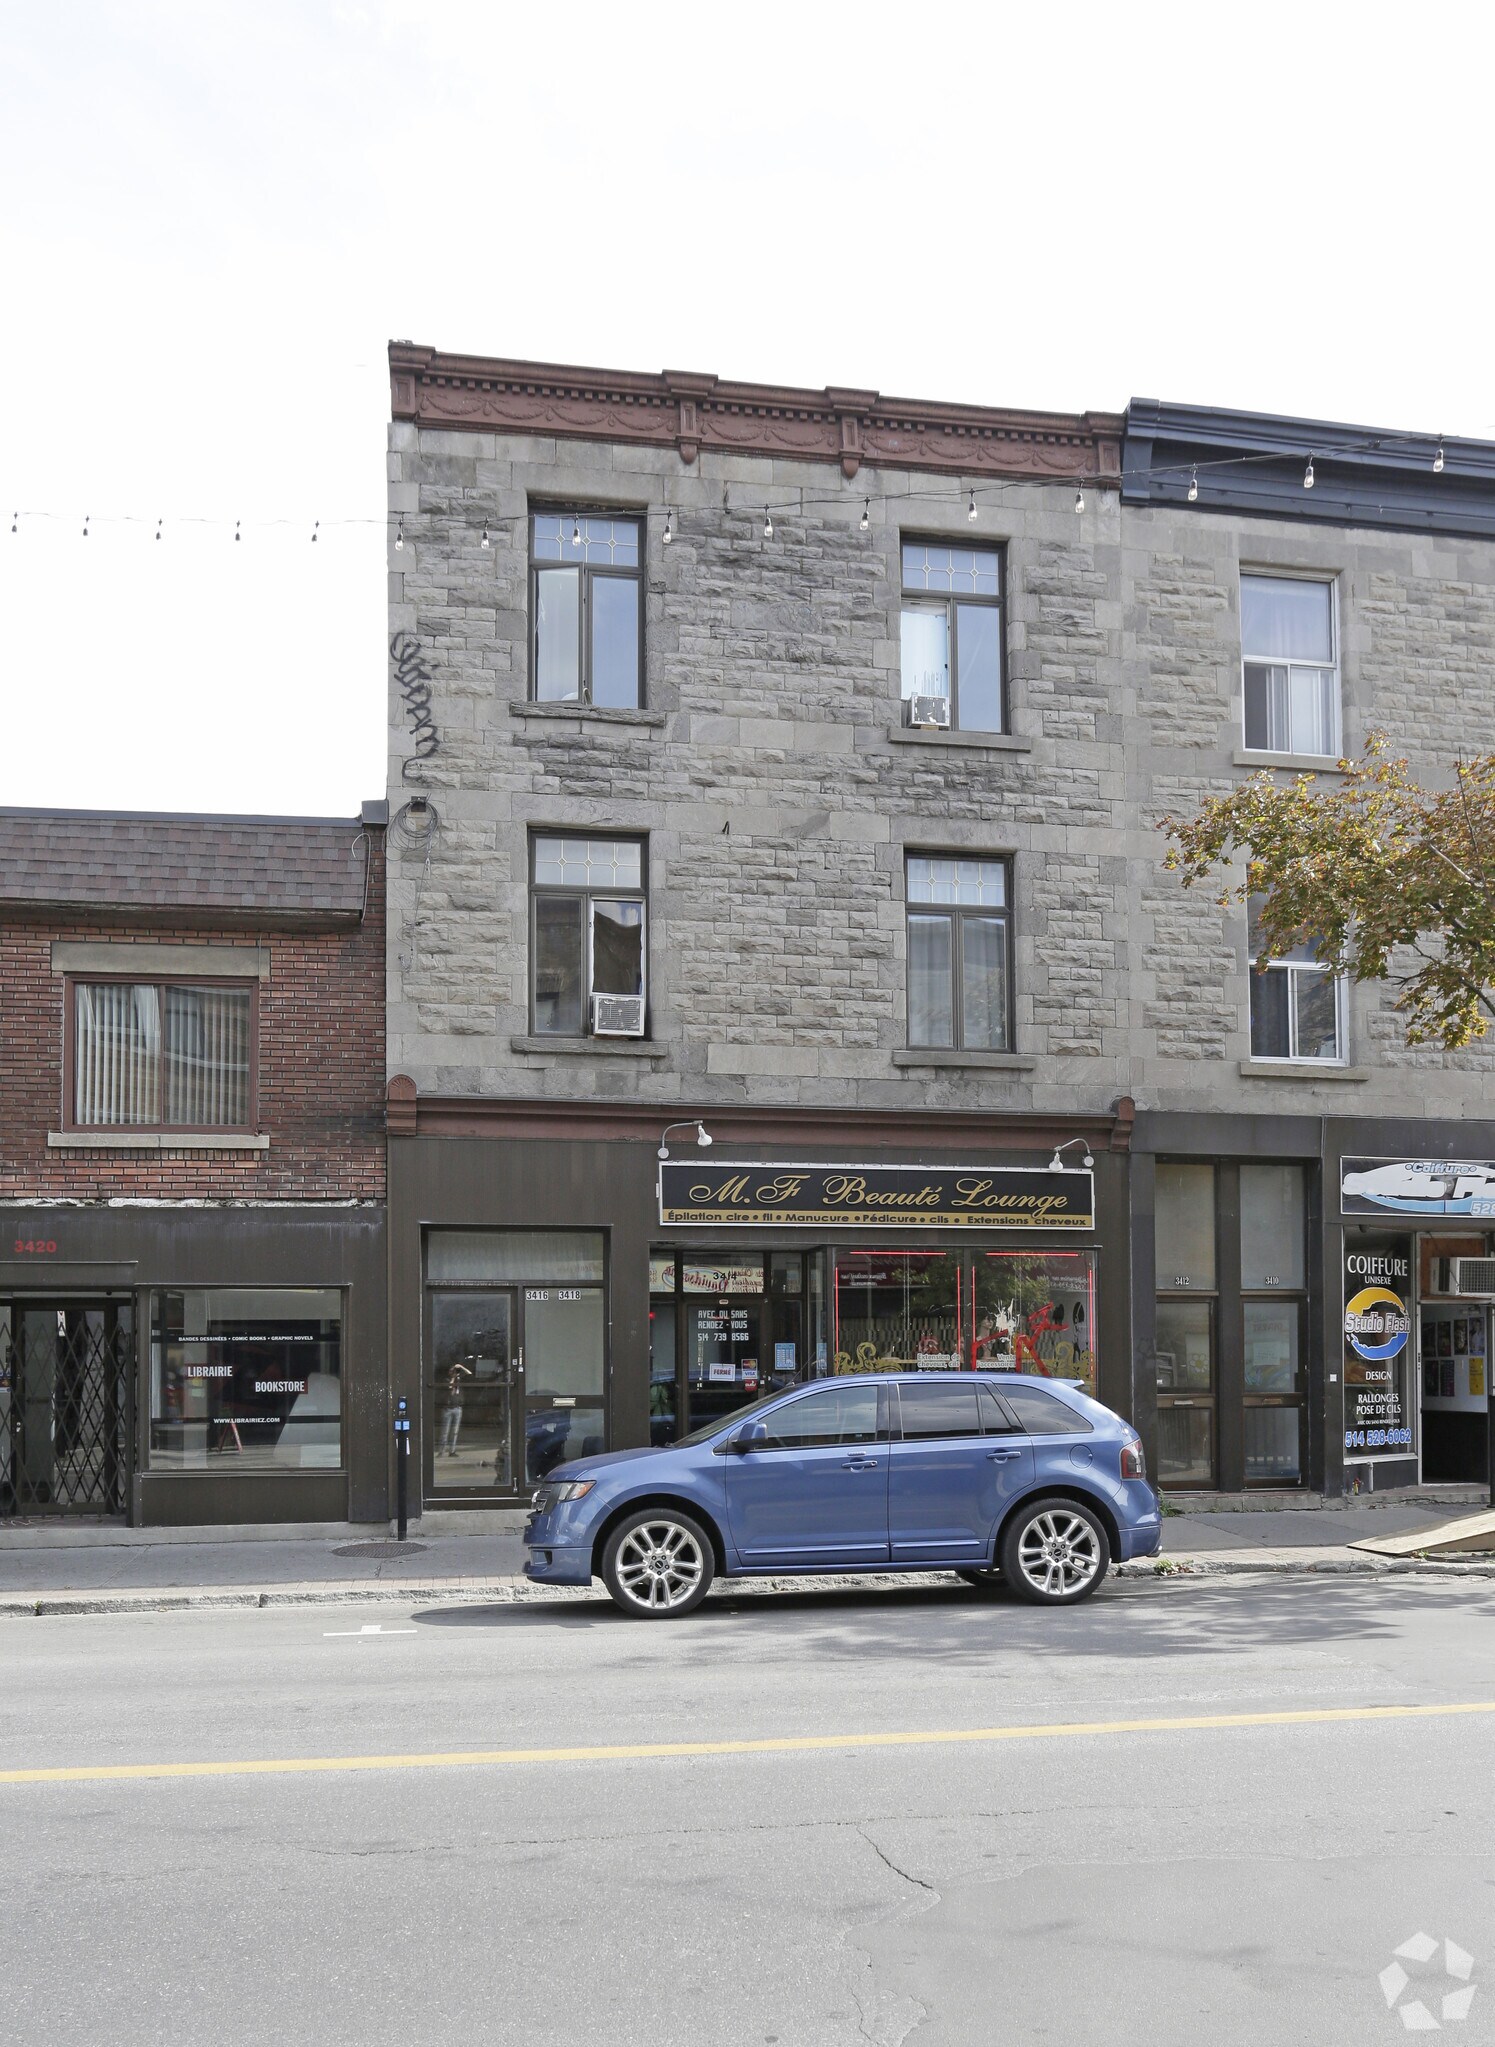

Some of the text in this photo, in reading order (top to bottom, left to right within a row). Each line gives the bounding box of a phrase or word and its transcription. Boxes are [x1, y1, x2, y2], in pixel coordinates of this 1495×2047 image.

[1412, 1162, 1469, 1173] Coiffure
[822, 1175, 943, 1209] Beauté
[951, 1178, 1069, 1218] Lounge
[668, 1210, 1087, 1226] Épilation cire fil Manucure Pédicure cils Extensions cheveux
[15, 1241, 57, 1253] 3420
[1347, 1255, 1408, 1276] COIFFURE
[713, 1272, 737, 1280] 3414
[1265, 1276, 1279, 1285] 3410
[1365, 1276, 1391, 1284] UNISEXE
[1175, 1277, 1190, 1286] 3412
[527, 1291, 548, 1300] 3416
[559, 1291, 580, 1300] 3418
[698, 1310, 748, 1318] AVEC OU SANS
[1345, 1312, 1411, 1333] Studio Flash
[917, 1361, 947, 1369] cheveux,
[188, 1366, 232, 1377] LIBRAIRIE
[1366, 1371, 1392, 1380] DESIGN
[255, 1381, 305, 1392] BOOKSTORE
[1358, 1393, 1399, 1403] RALLONGES
[1356, 1404, 1401, 1414] POSE DE CILS
[1345, 1428, 1411, 1447] 514 528-6062
